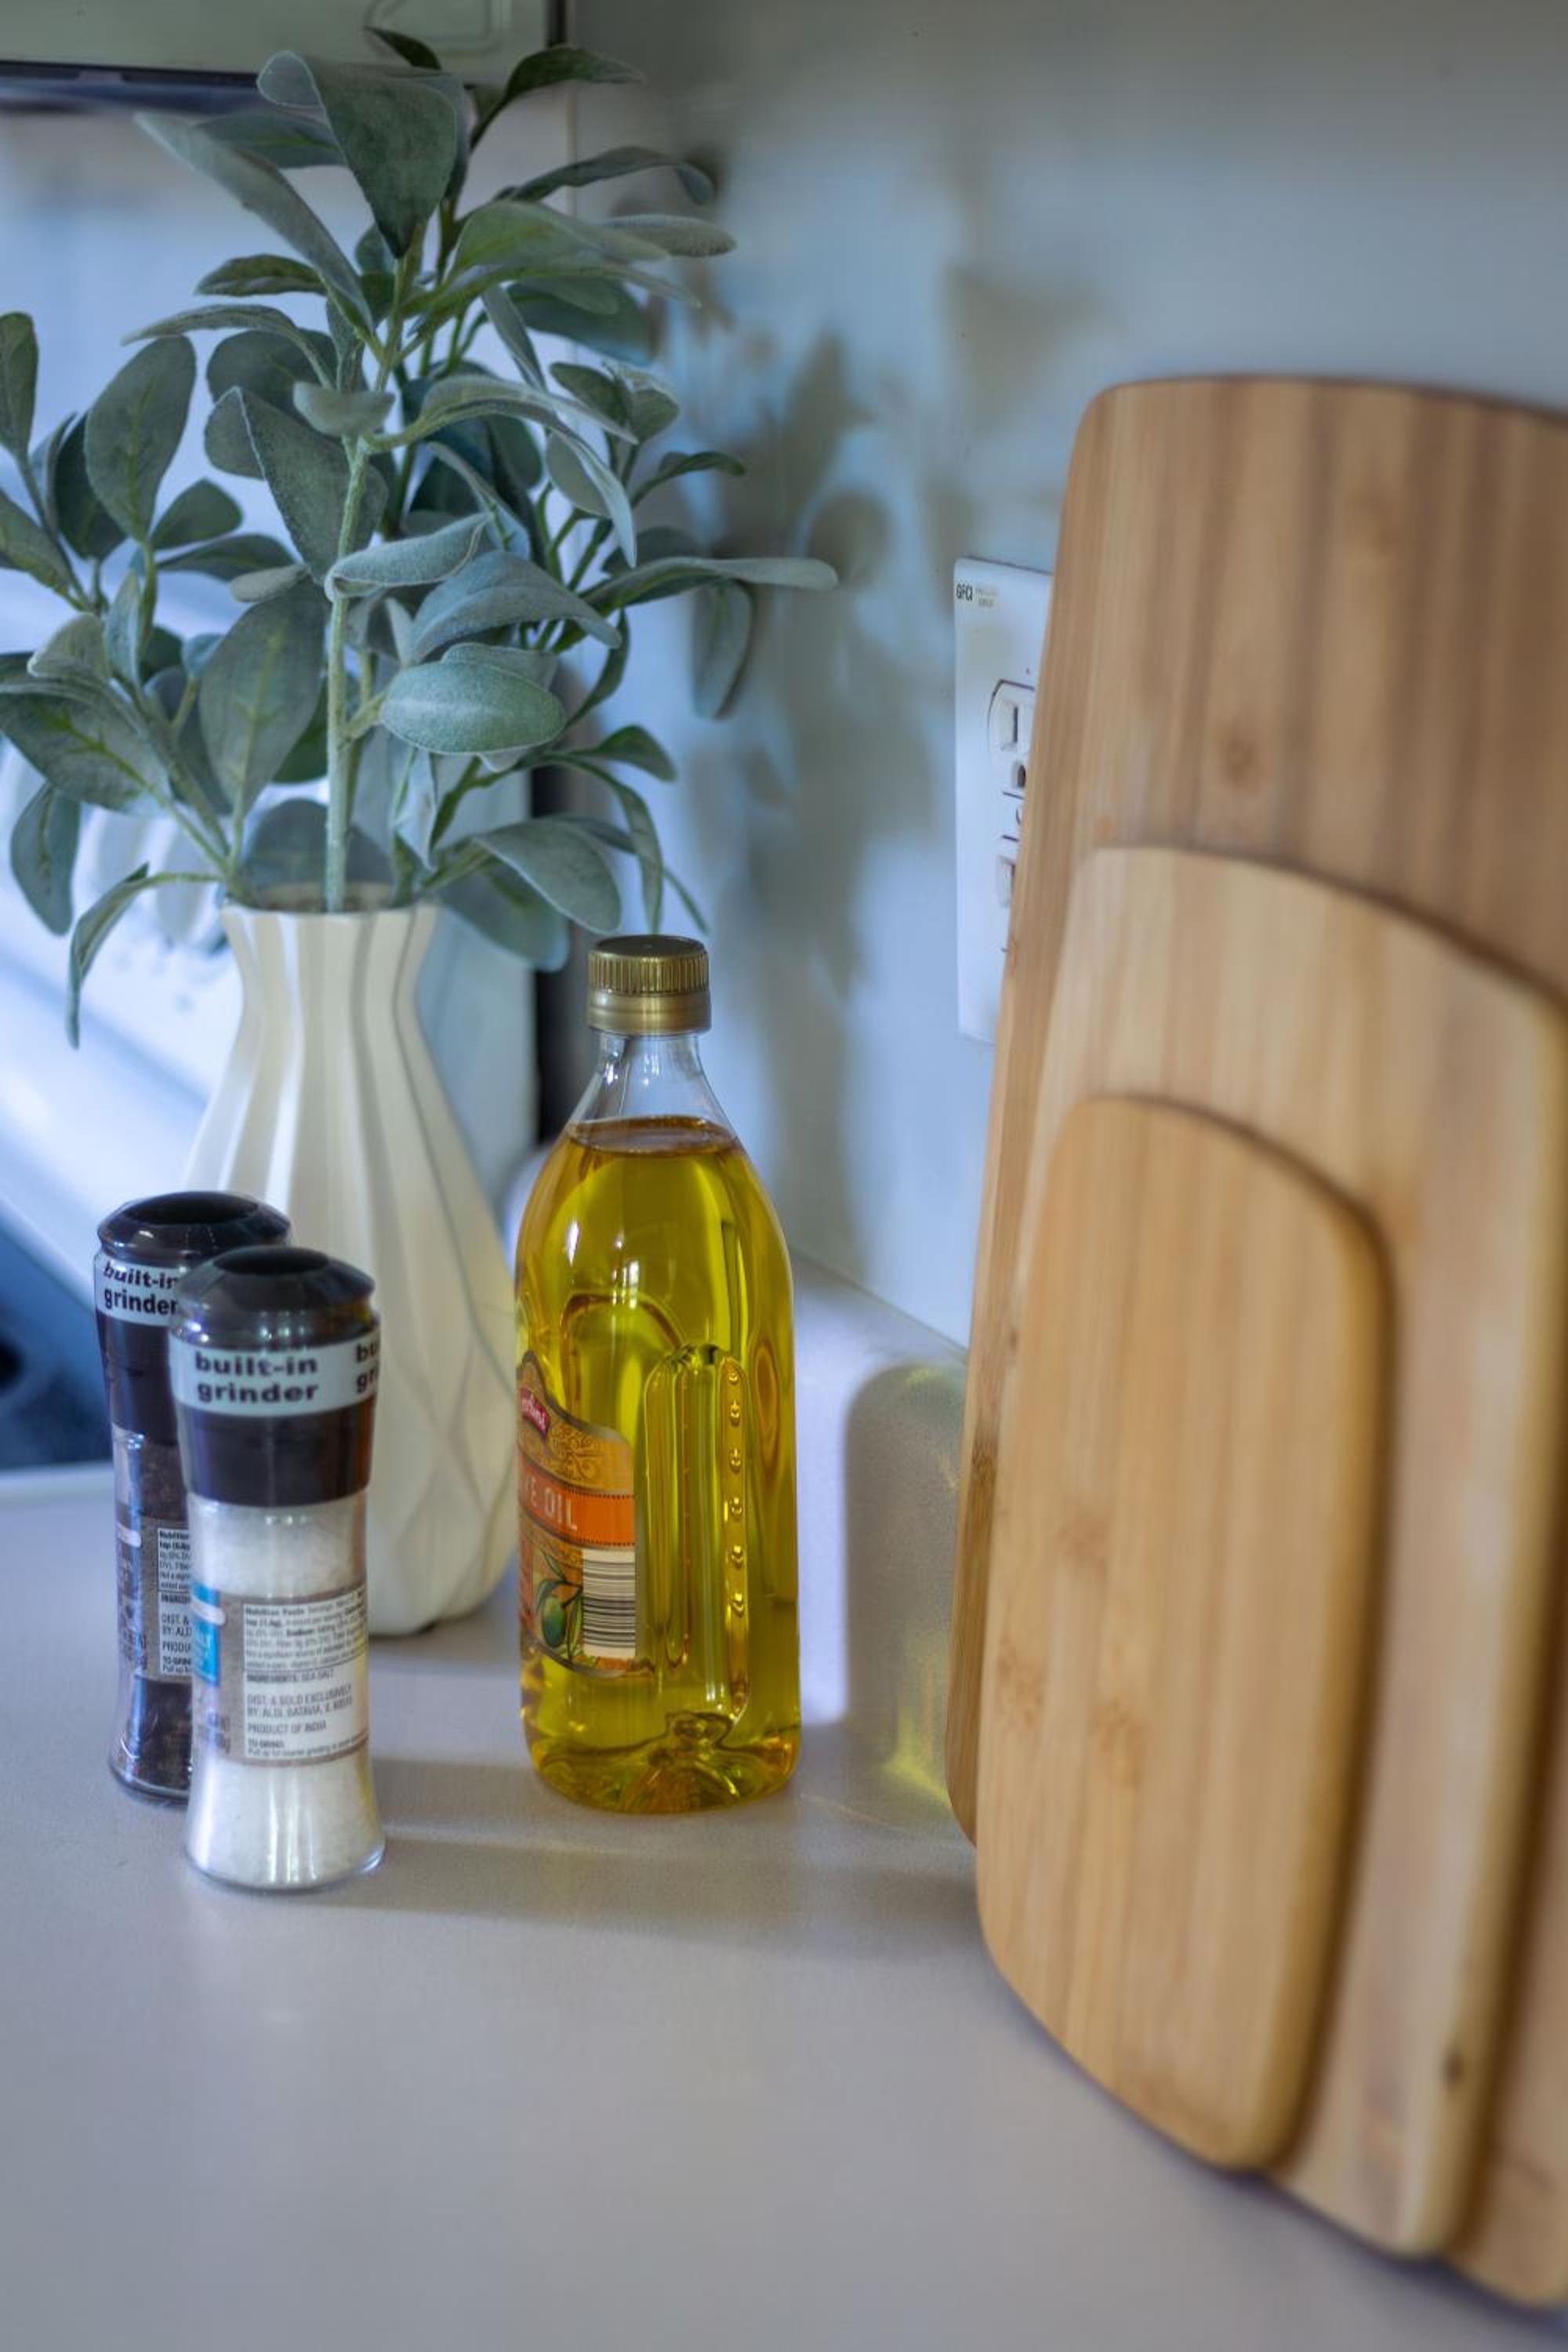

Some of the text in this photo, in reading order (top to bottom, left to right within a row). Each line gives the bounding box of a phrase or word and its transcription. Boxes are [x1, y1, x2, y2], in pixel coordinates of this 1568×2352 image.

[956, 582, 973, 601] GFCI
[104, 1287, 177, 1316] grinder
[195, 1351, 318, 1377] built-in
[197, 1382, 319, 1403] grinder
[545, 1486, 579, 1531] OIL
